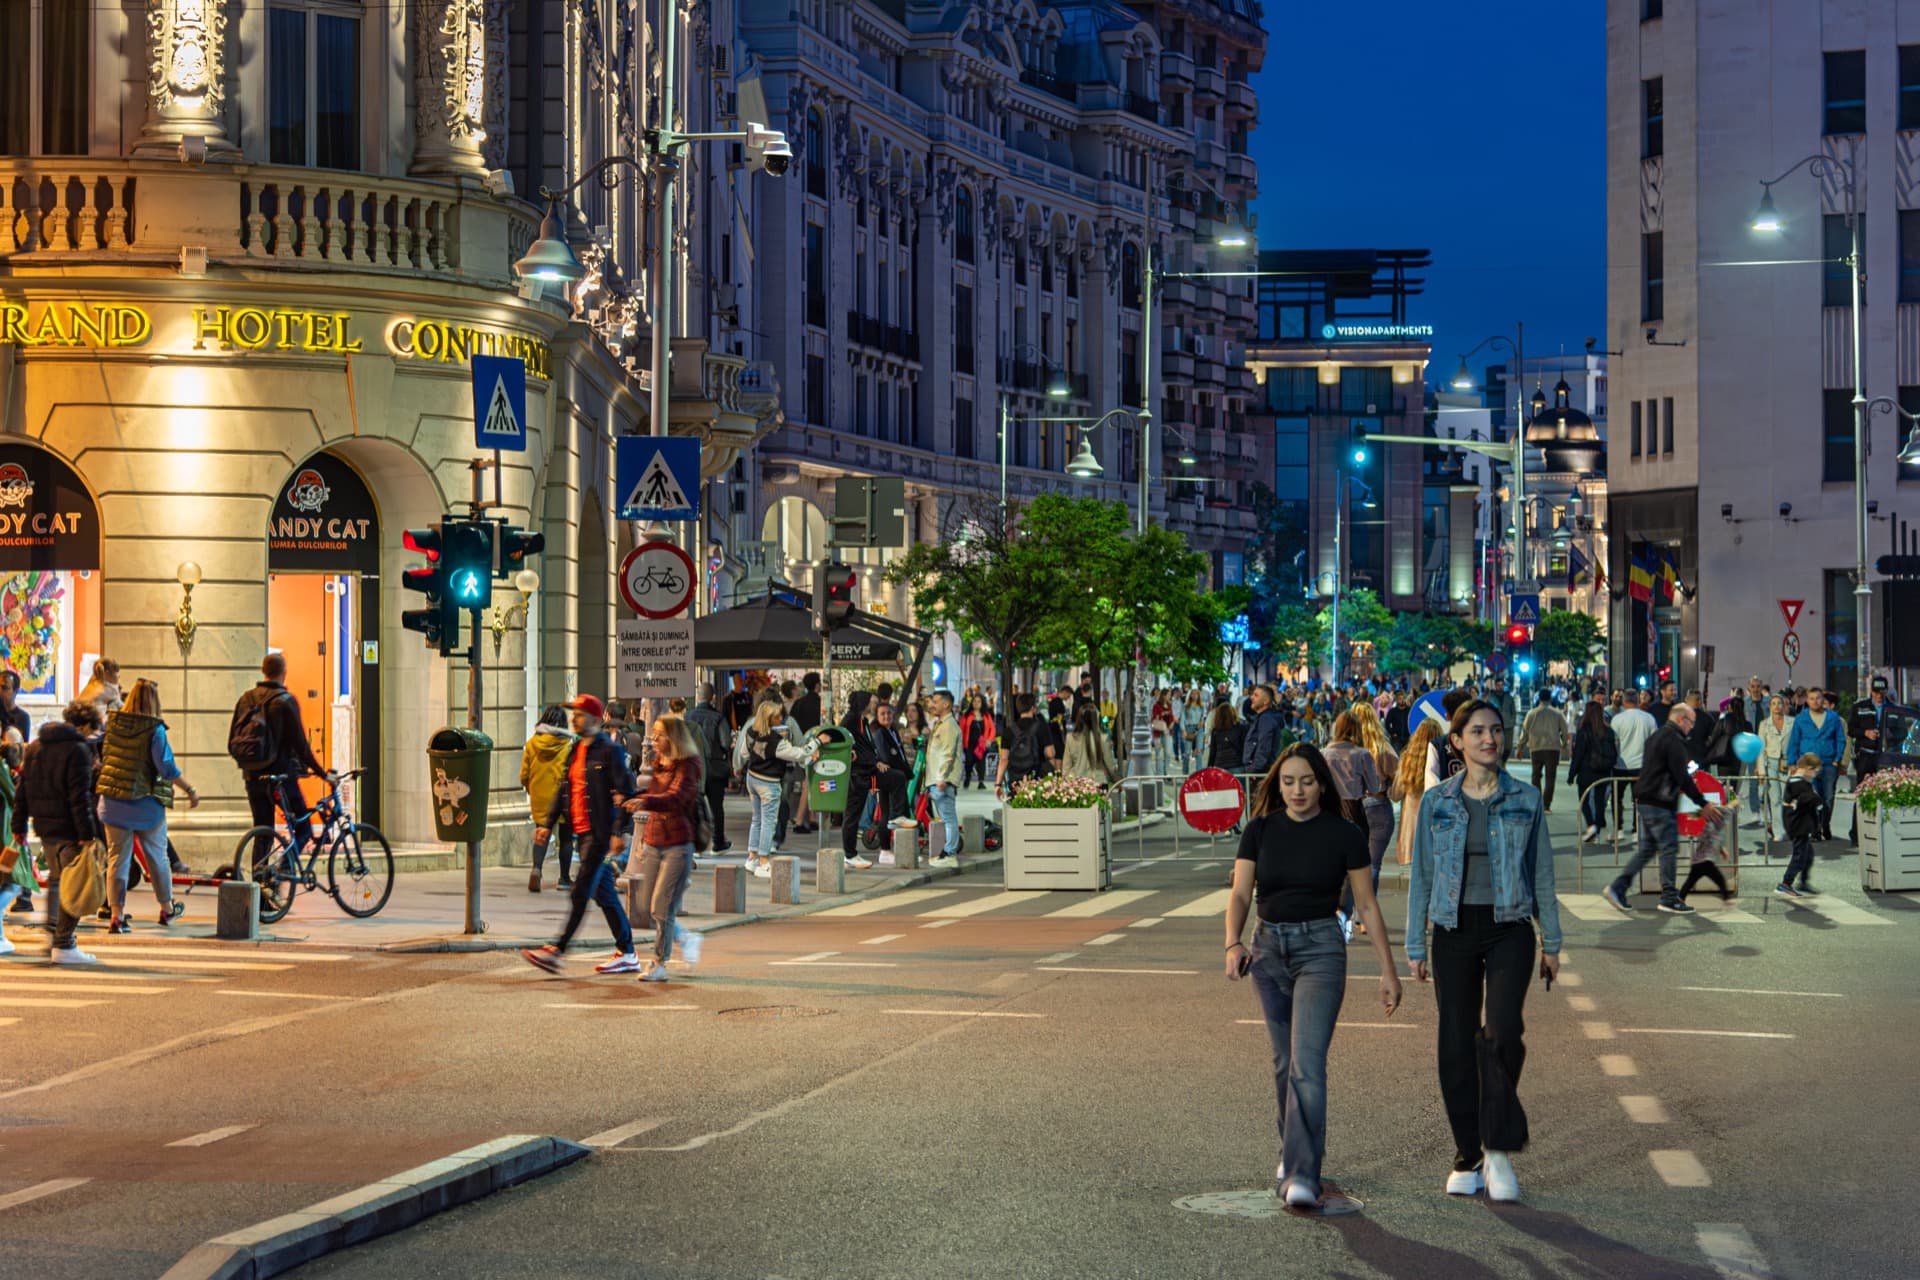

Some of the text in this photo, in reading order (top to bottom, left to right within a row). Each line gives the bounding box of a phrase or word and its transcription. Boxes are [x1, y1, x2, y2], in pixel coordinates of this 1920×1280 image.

[0, 305, 150, 345] RAND
[192, 306, 363, 351] HOTEL
[1337, 325, 1433, 336] VISIONAPARTMENTS
[32, 512, 82, 534] CAT
[327, 518, 370, 539] CAT
[270, 540, 348, 550] LUMEA DULCIURILOR
[642, 647, 664, 656] ORELE
[831, 644, 870, 655] SERVE
[624, 662, 687, 672] INTERZIS BICICLETE
[643, 678, 678, 688] TROTINETE
